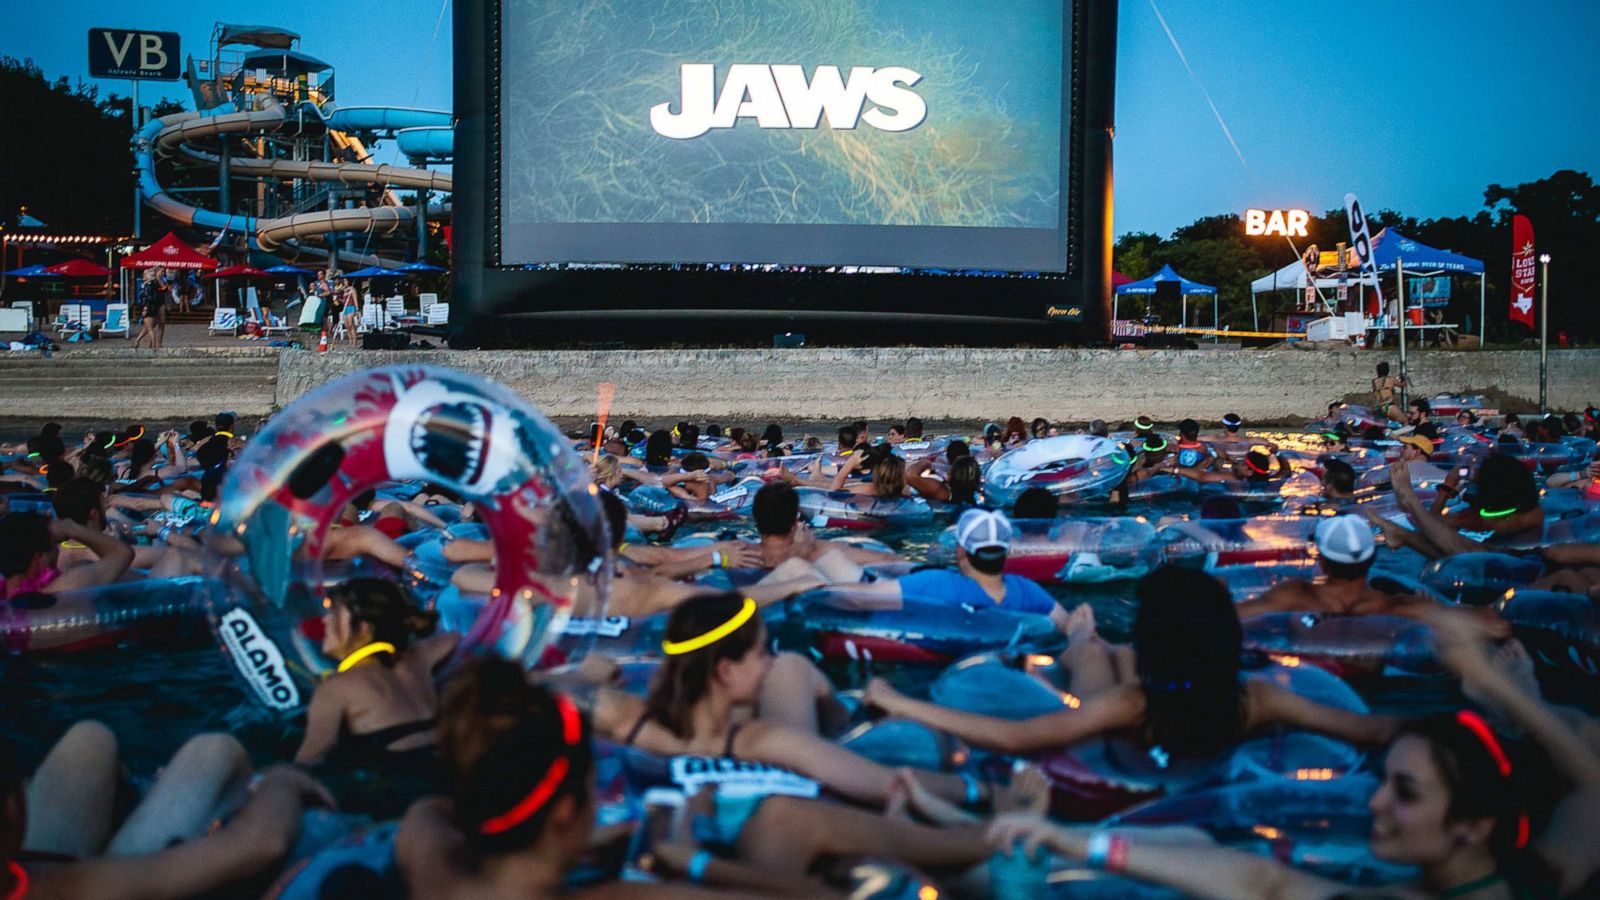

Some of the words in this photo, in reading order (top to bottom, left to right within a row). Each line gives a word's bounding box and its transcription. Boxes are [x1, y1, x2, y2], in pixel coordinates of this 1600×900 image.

[102, 31, 168, 70] VB
[649, 63, 928, 140] JAWS
[1246, 209, 1309, 237] BAR
[1047, 306, 1067, 317] Open
[229, 619, 291, 703] ALAMO
